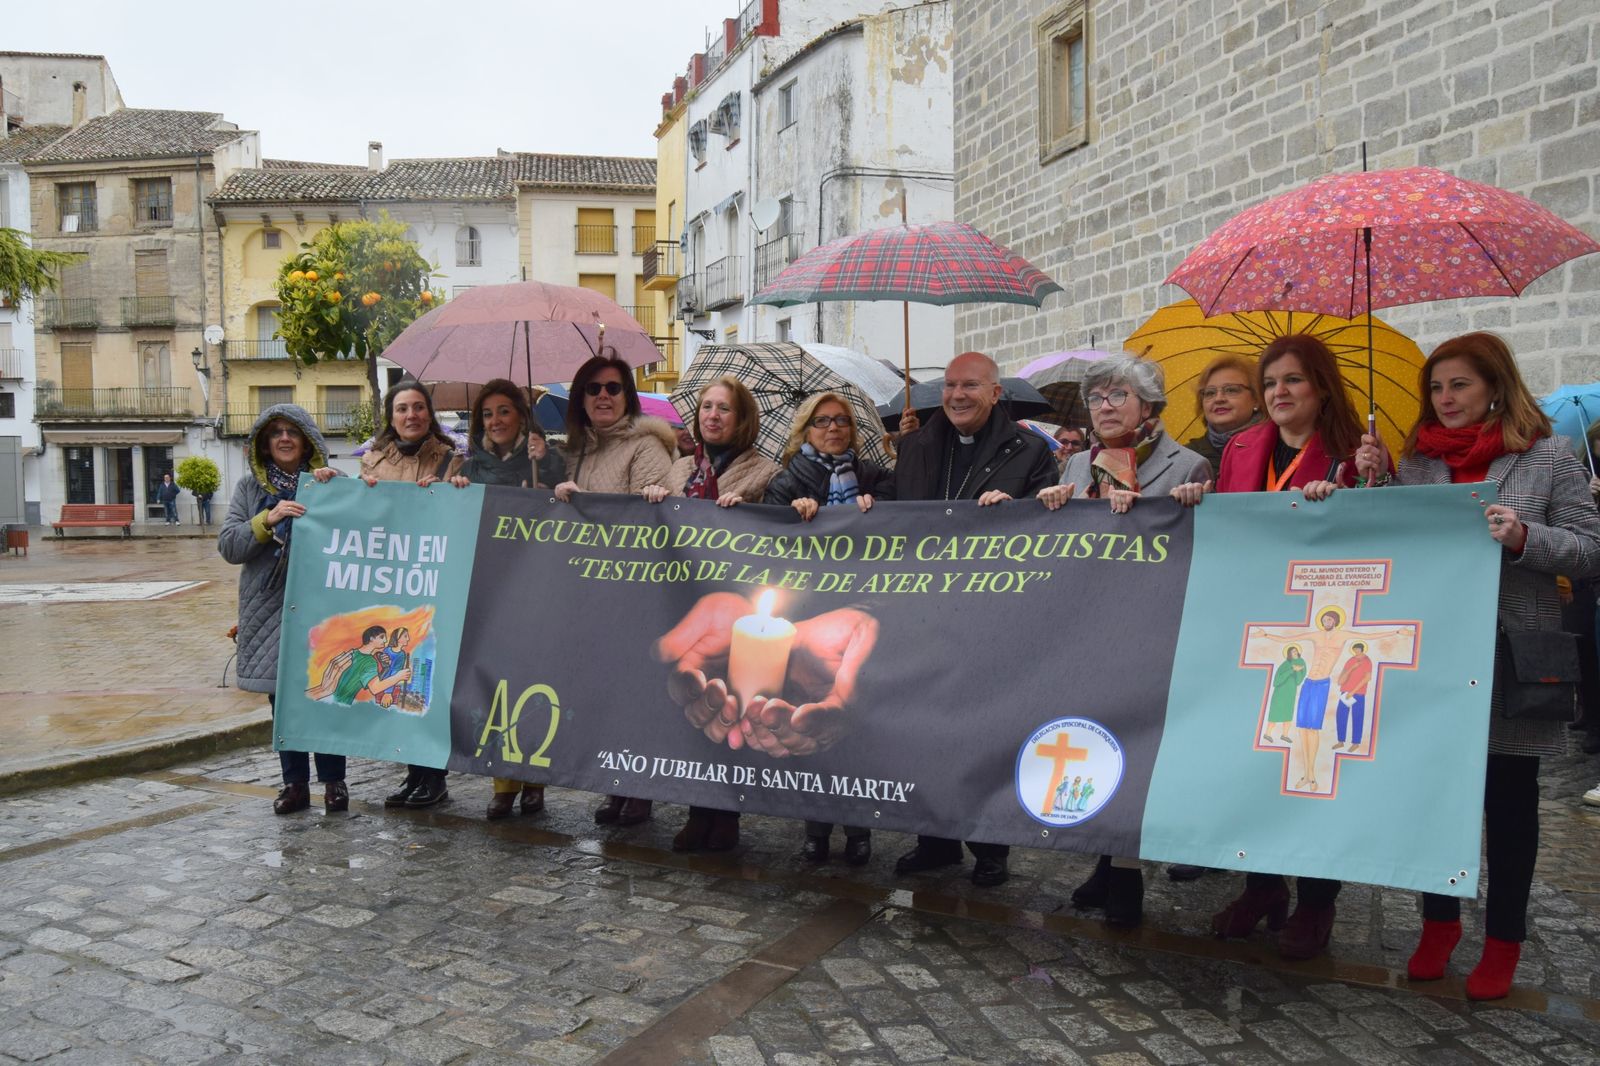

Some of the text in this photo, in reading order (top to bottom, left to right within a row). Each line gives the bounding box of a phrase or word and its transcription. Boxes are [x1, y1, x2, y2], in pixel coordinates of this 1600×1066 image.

[322, 526, 448, 563] JAÉN EN
[491, 515, 1170, 563] ENCUENTRO DIOCESANO DE CATEQUISTAS
[325, 561, 439, 597] MISIÓN
[694, 559, 732, 581] DE
[733, 564, 770, 585] LA
[777, 569, 811, 590] FE
[814, 573, 857, 593] DE
[857, 572, 933, 593] AYER
[938, 573, 963, 593] Y
[649, 757, 728, 784] JUBILAR
[732, 766, 757, 786] DE
[761, 768, 825, 794] SANTA
